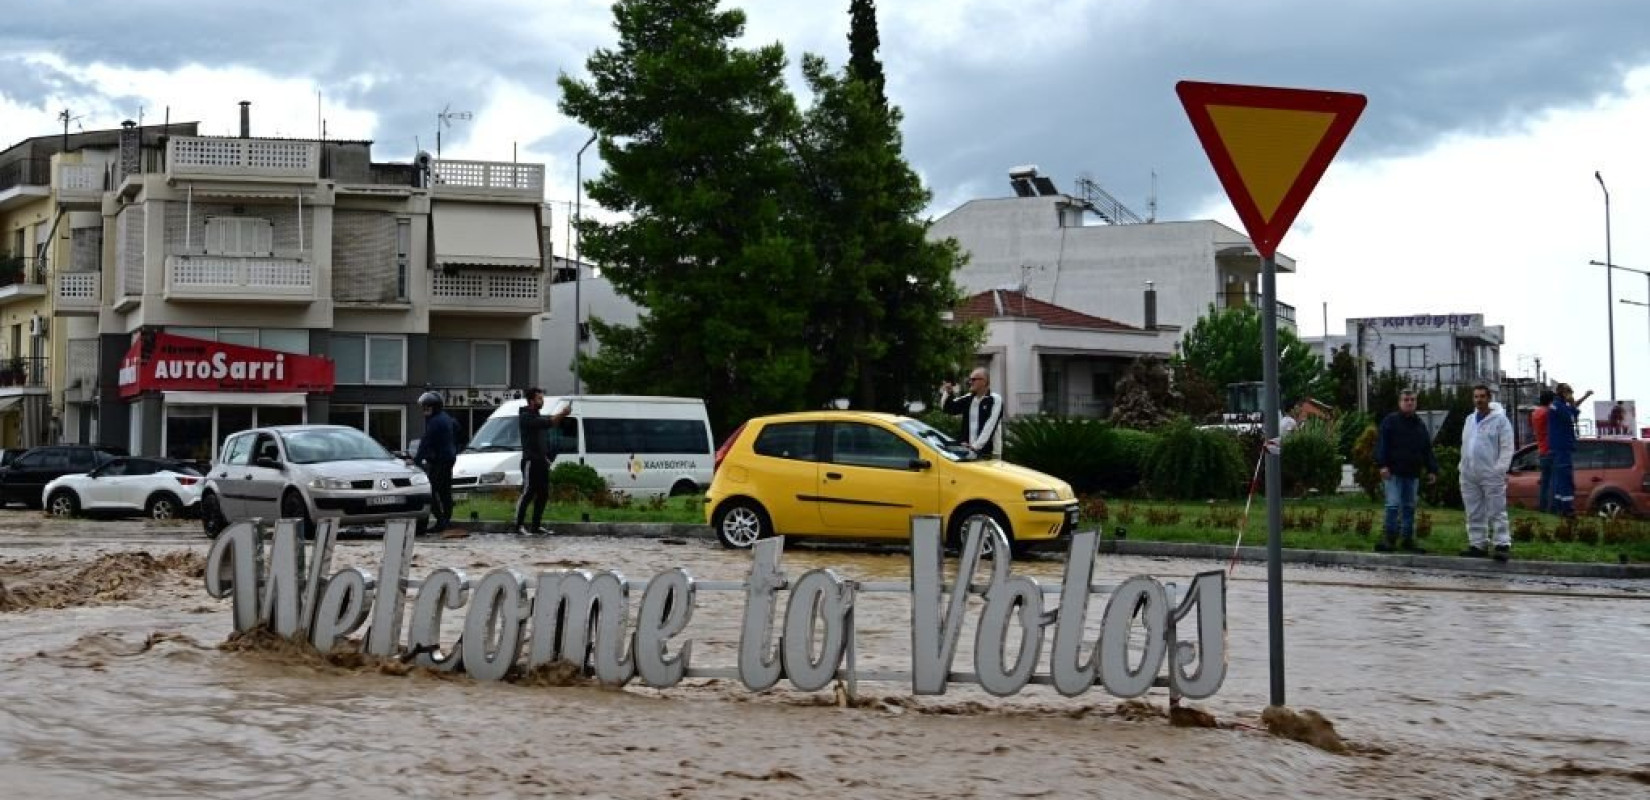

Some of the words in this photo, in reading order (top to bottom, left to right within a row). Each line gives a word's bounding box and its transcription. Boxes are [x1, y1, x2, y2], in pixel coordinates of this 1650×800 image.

[205, 517, 698, 689] Welcome
[738, 535, 855, 693] to
[909, 515, 1227, 698] Volos
